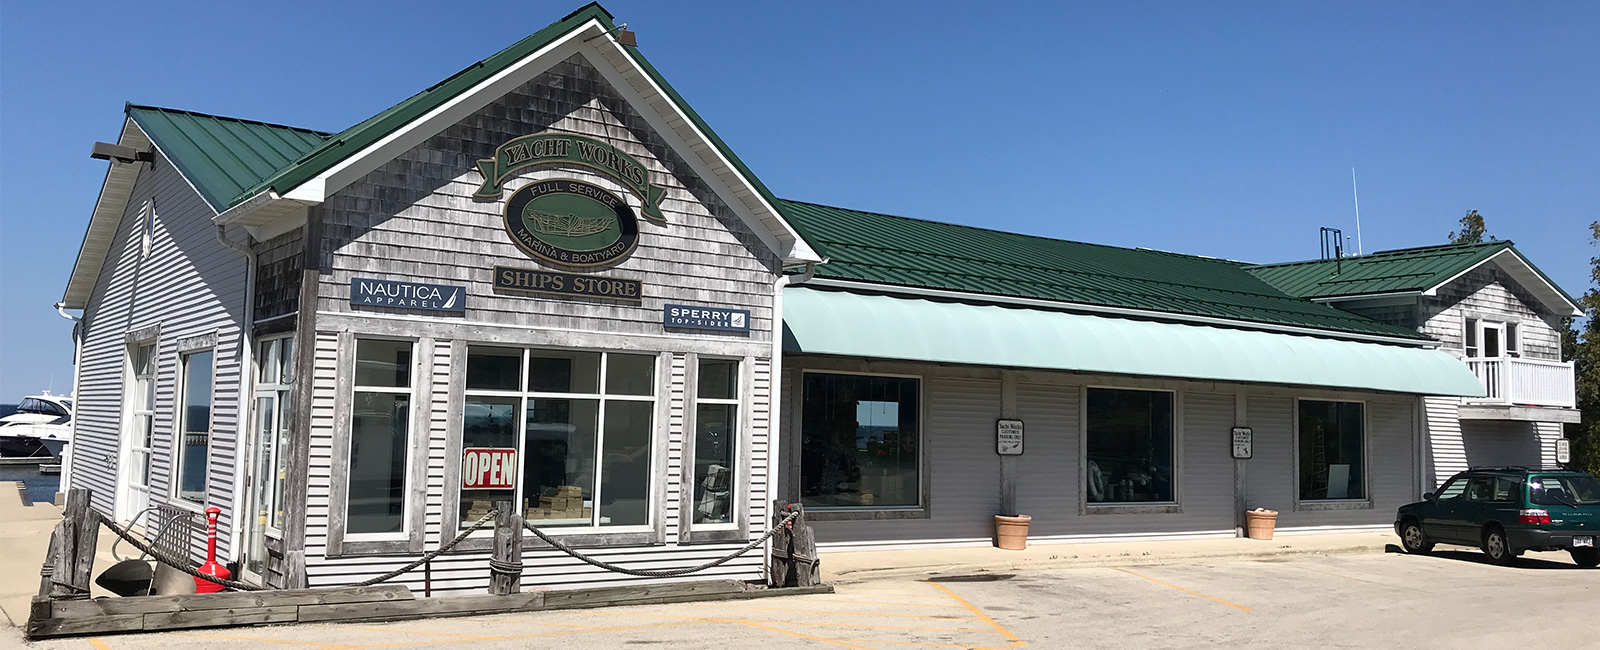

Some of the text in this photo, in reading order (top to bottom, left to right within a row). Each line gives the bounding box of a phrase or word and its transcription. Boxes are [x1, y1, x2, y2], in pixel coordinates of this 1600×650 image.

[504, 139, 644, 186] YACHT WORKS
[530, 182, 618, 209] FULL SERVICE
[517, 228, 625, 263] MARINA & BOATYARD
[360, 281, 442, 300] NAUTICA
[501, 269, 637, 297] SHIPS STORE
[364, 296, 438, 308] APPAREL
[670, 307, 730, 320] SPERRY
[671, 317, 729, 328] TOP-SIDER
[465, 451, 515, 486] OPEN
